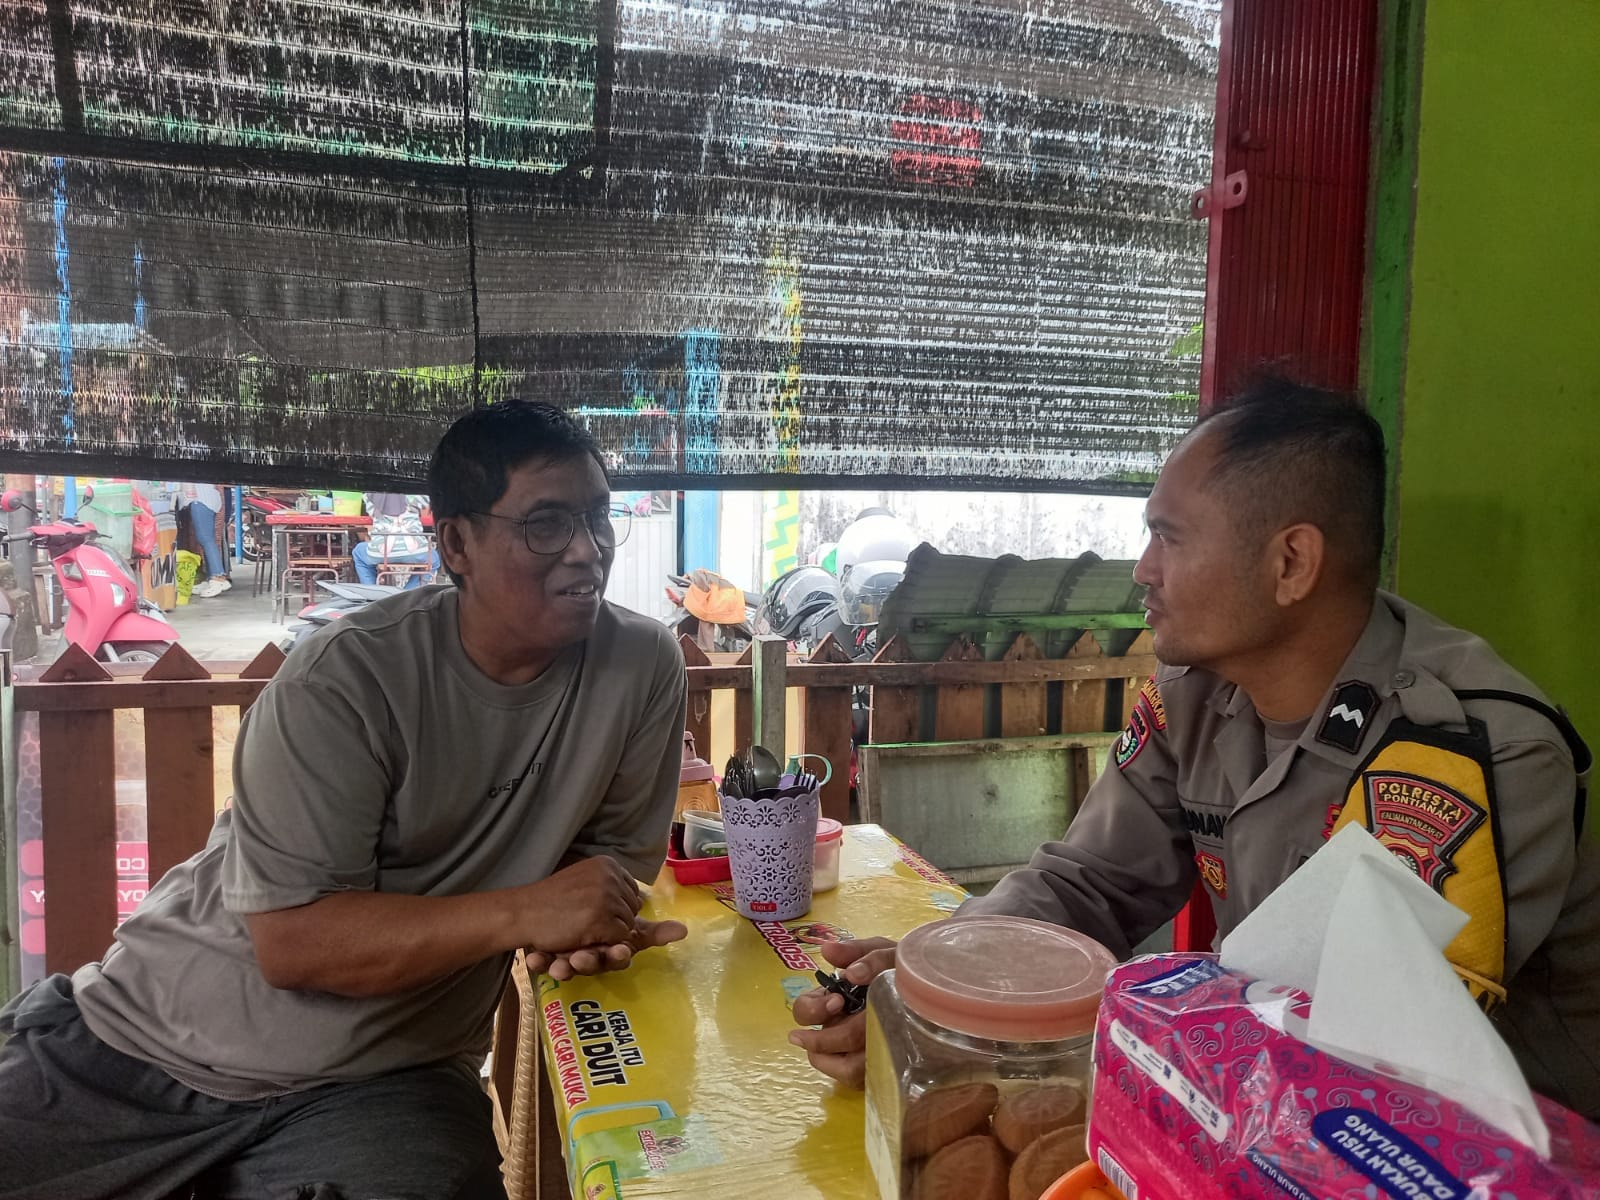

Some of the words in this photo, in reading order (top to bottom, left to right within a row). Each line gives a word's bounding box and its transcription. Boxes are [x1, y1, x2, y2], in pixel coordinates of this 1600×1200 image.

[1378, 782, 1463, 821] POLRESTA
[1384, 793, 1454, 823] PONTIANAK
[543, 1000, 569, 1042] BUKAN
[569, 1000, 610, 1041] CARI
[605, 1010, 636, 1046] KERJA
[553, 1038, 578, 1070] CARI
[581, 1042, 628, 1087] DUIT
[619, 1047, 644, 1066] ITU
[560, 1065, 588, 1110] MUKA
[1330, 1129, 1373, 1161] TISU
[1343, 1114, 1406, 1159] ULANG
[1252, 1153, 1278, 1179] ULANG
[1276, 1173, 1300, 1197] DAUR
[1365, 1154, 1433, 1200] BUKAN
[1396, 1152, 1456, 1200] DAUR
